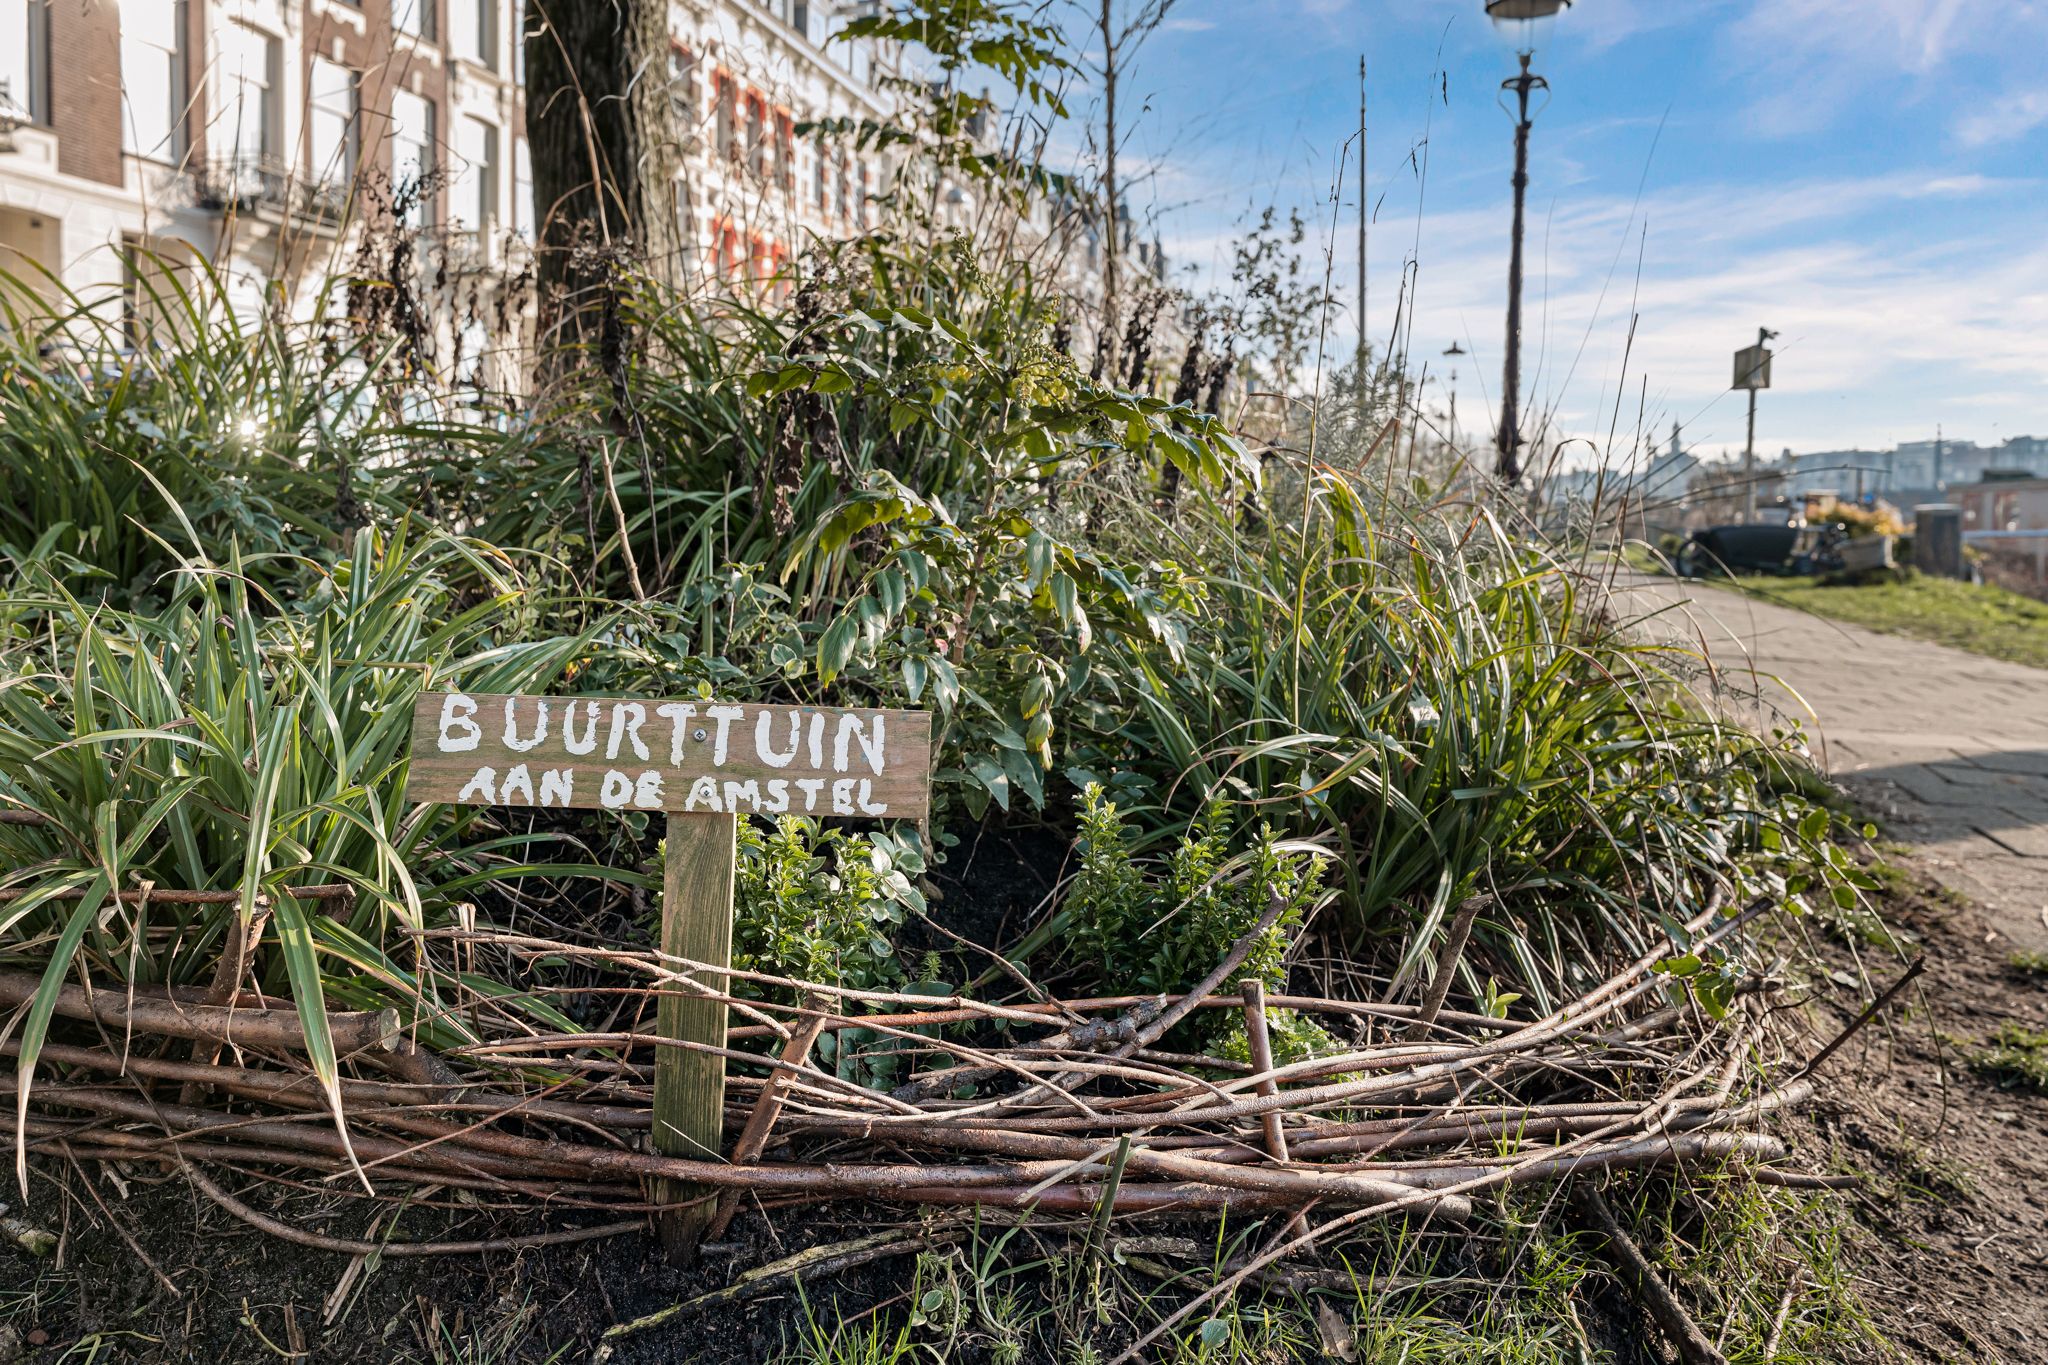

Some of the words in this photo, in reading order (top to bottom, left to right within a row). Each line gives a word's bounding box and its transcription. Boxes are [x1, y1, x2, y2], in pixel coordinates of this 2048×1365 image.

[437, 693, 885, 776] BUURTTUIN
[458, 763, 573, 807] AAN
[601, 769, 665, 809] DE
[685, 775, 888, 817] AMSTEL
